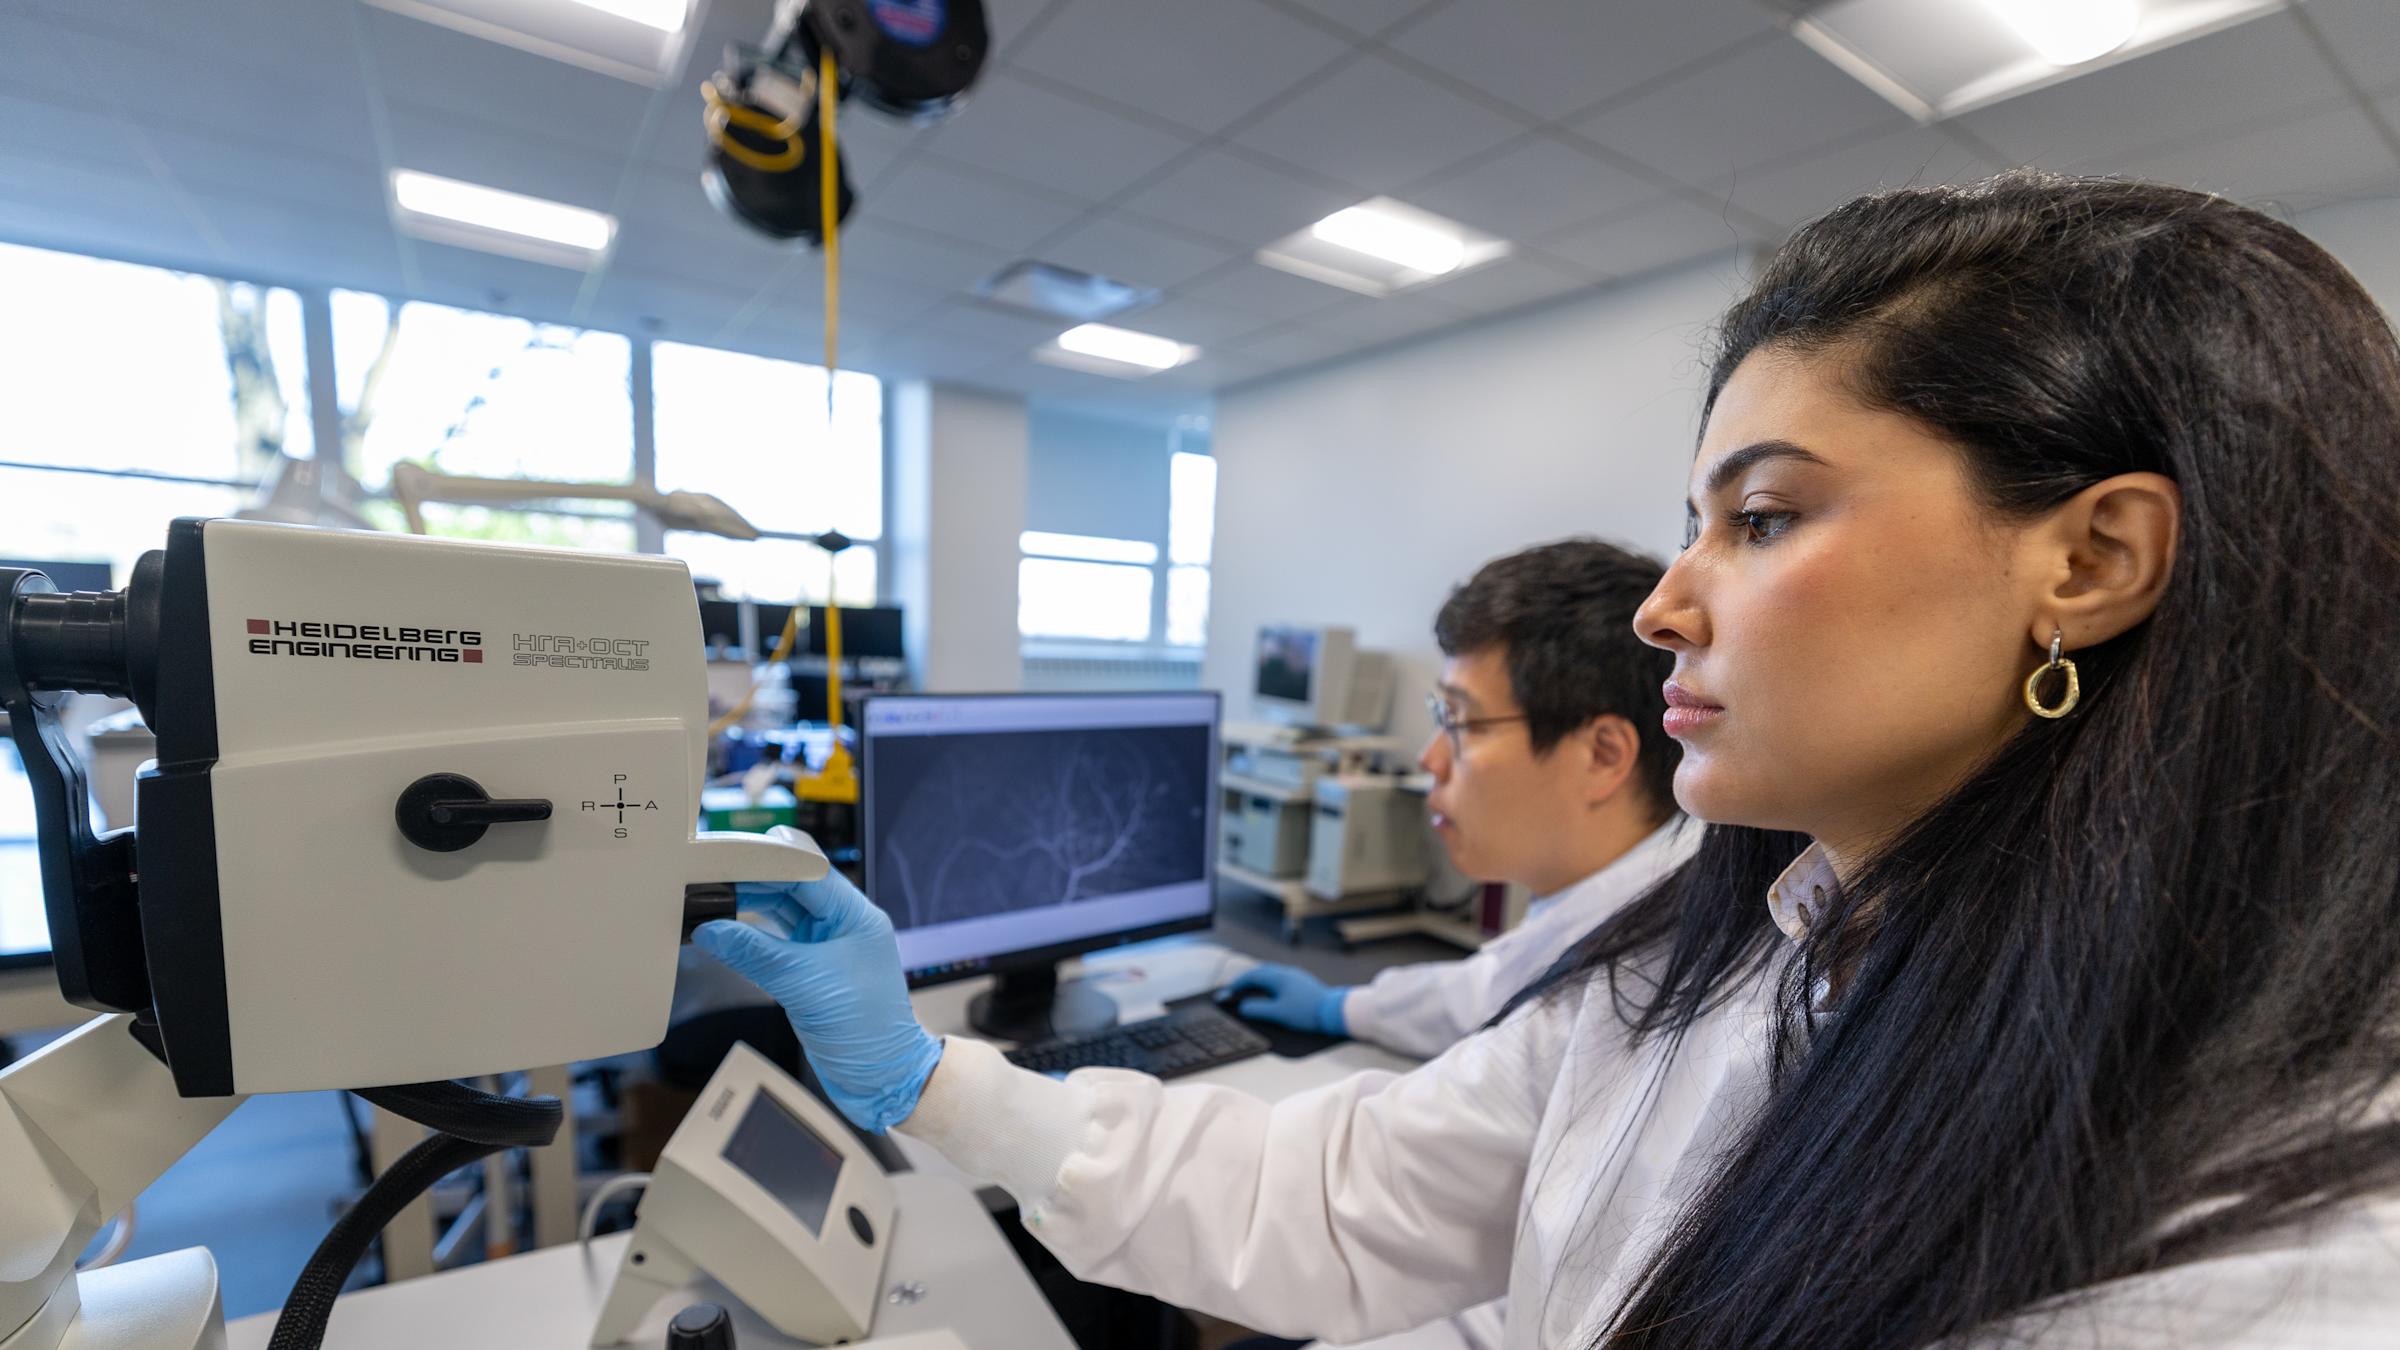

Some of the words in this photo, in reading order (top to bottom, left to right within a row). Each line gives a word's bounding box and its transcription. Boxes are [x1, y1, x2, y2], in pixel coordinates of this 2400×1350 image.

[273, 620, 482, 646] HEIDELBERG
[248, 638, 460, 663] ENGINEERING
[613, 773, 628, 785] P
[581, 800, 596, 812] R
[644, 800, 659, 811] A
[614, 828, 628, 839] S
